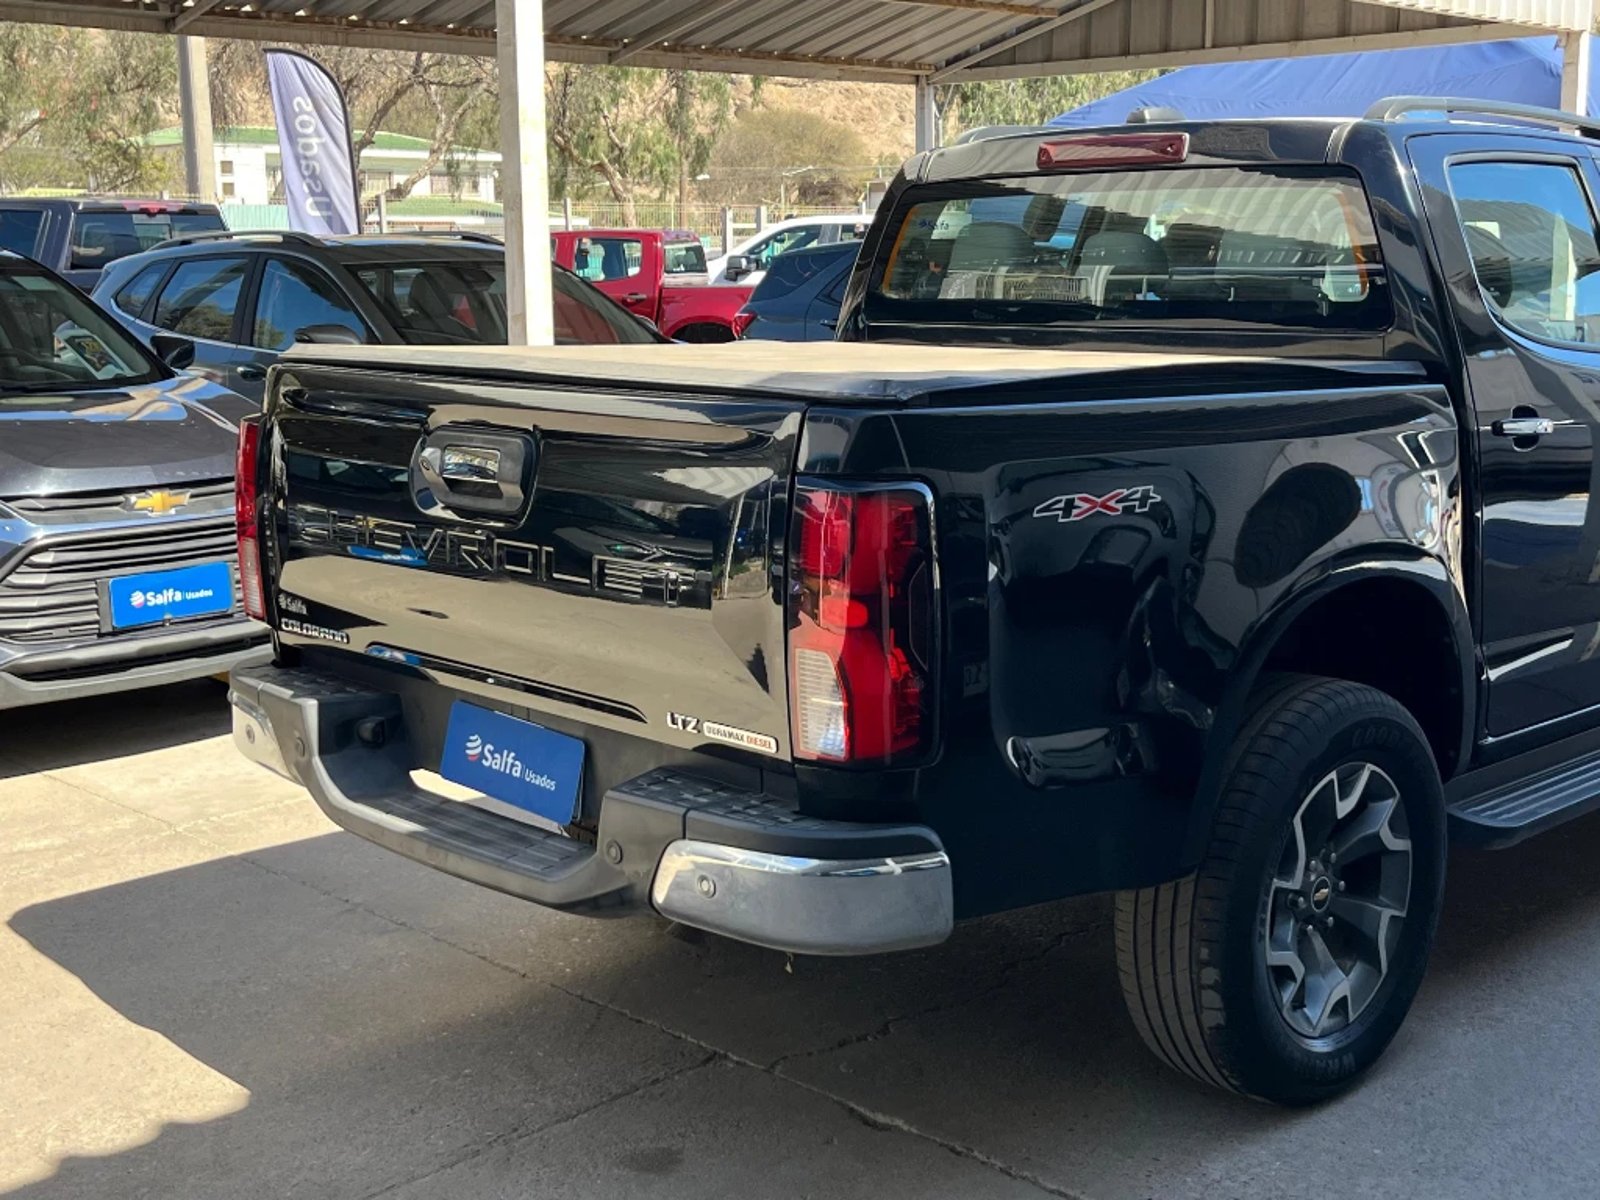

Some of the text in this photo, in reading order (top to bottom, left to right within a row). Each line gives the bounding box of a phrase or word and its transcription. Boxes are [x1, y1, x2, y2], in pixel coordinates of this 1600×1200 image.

[146, 588, 213, 606] Salfa Usados
[667, 711, 699, 733] LTZ
[746, 735, 773, 750] DIESEL
[482, 744, 557, 791] Salfa Usados
